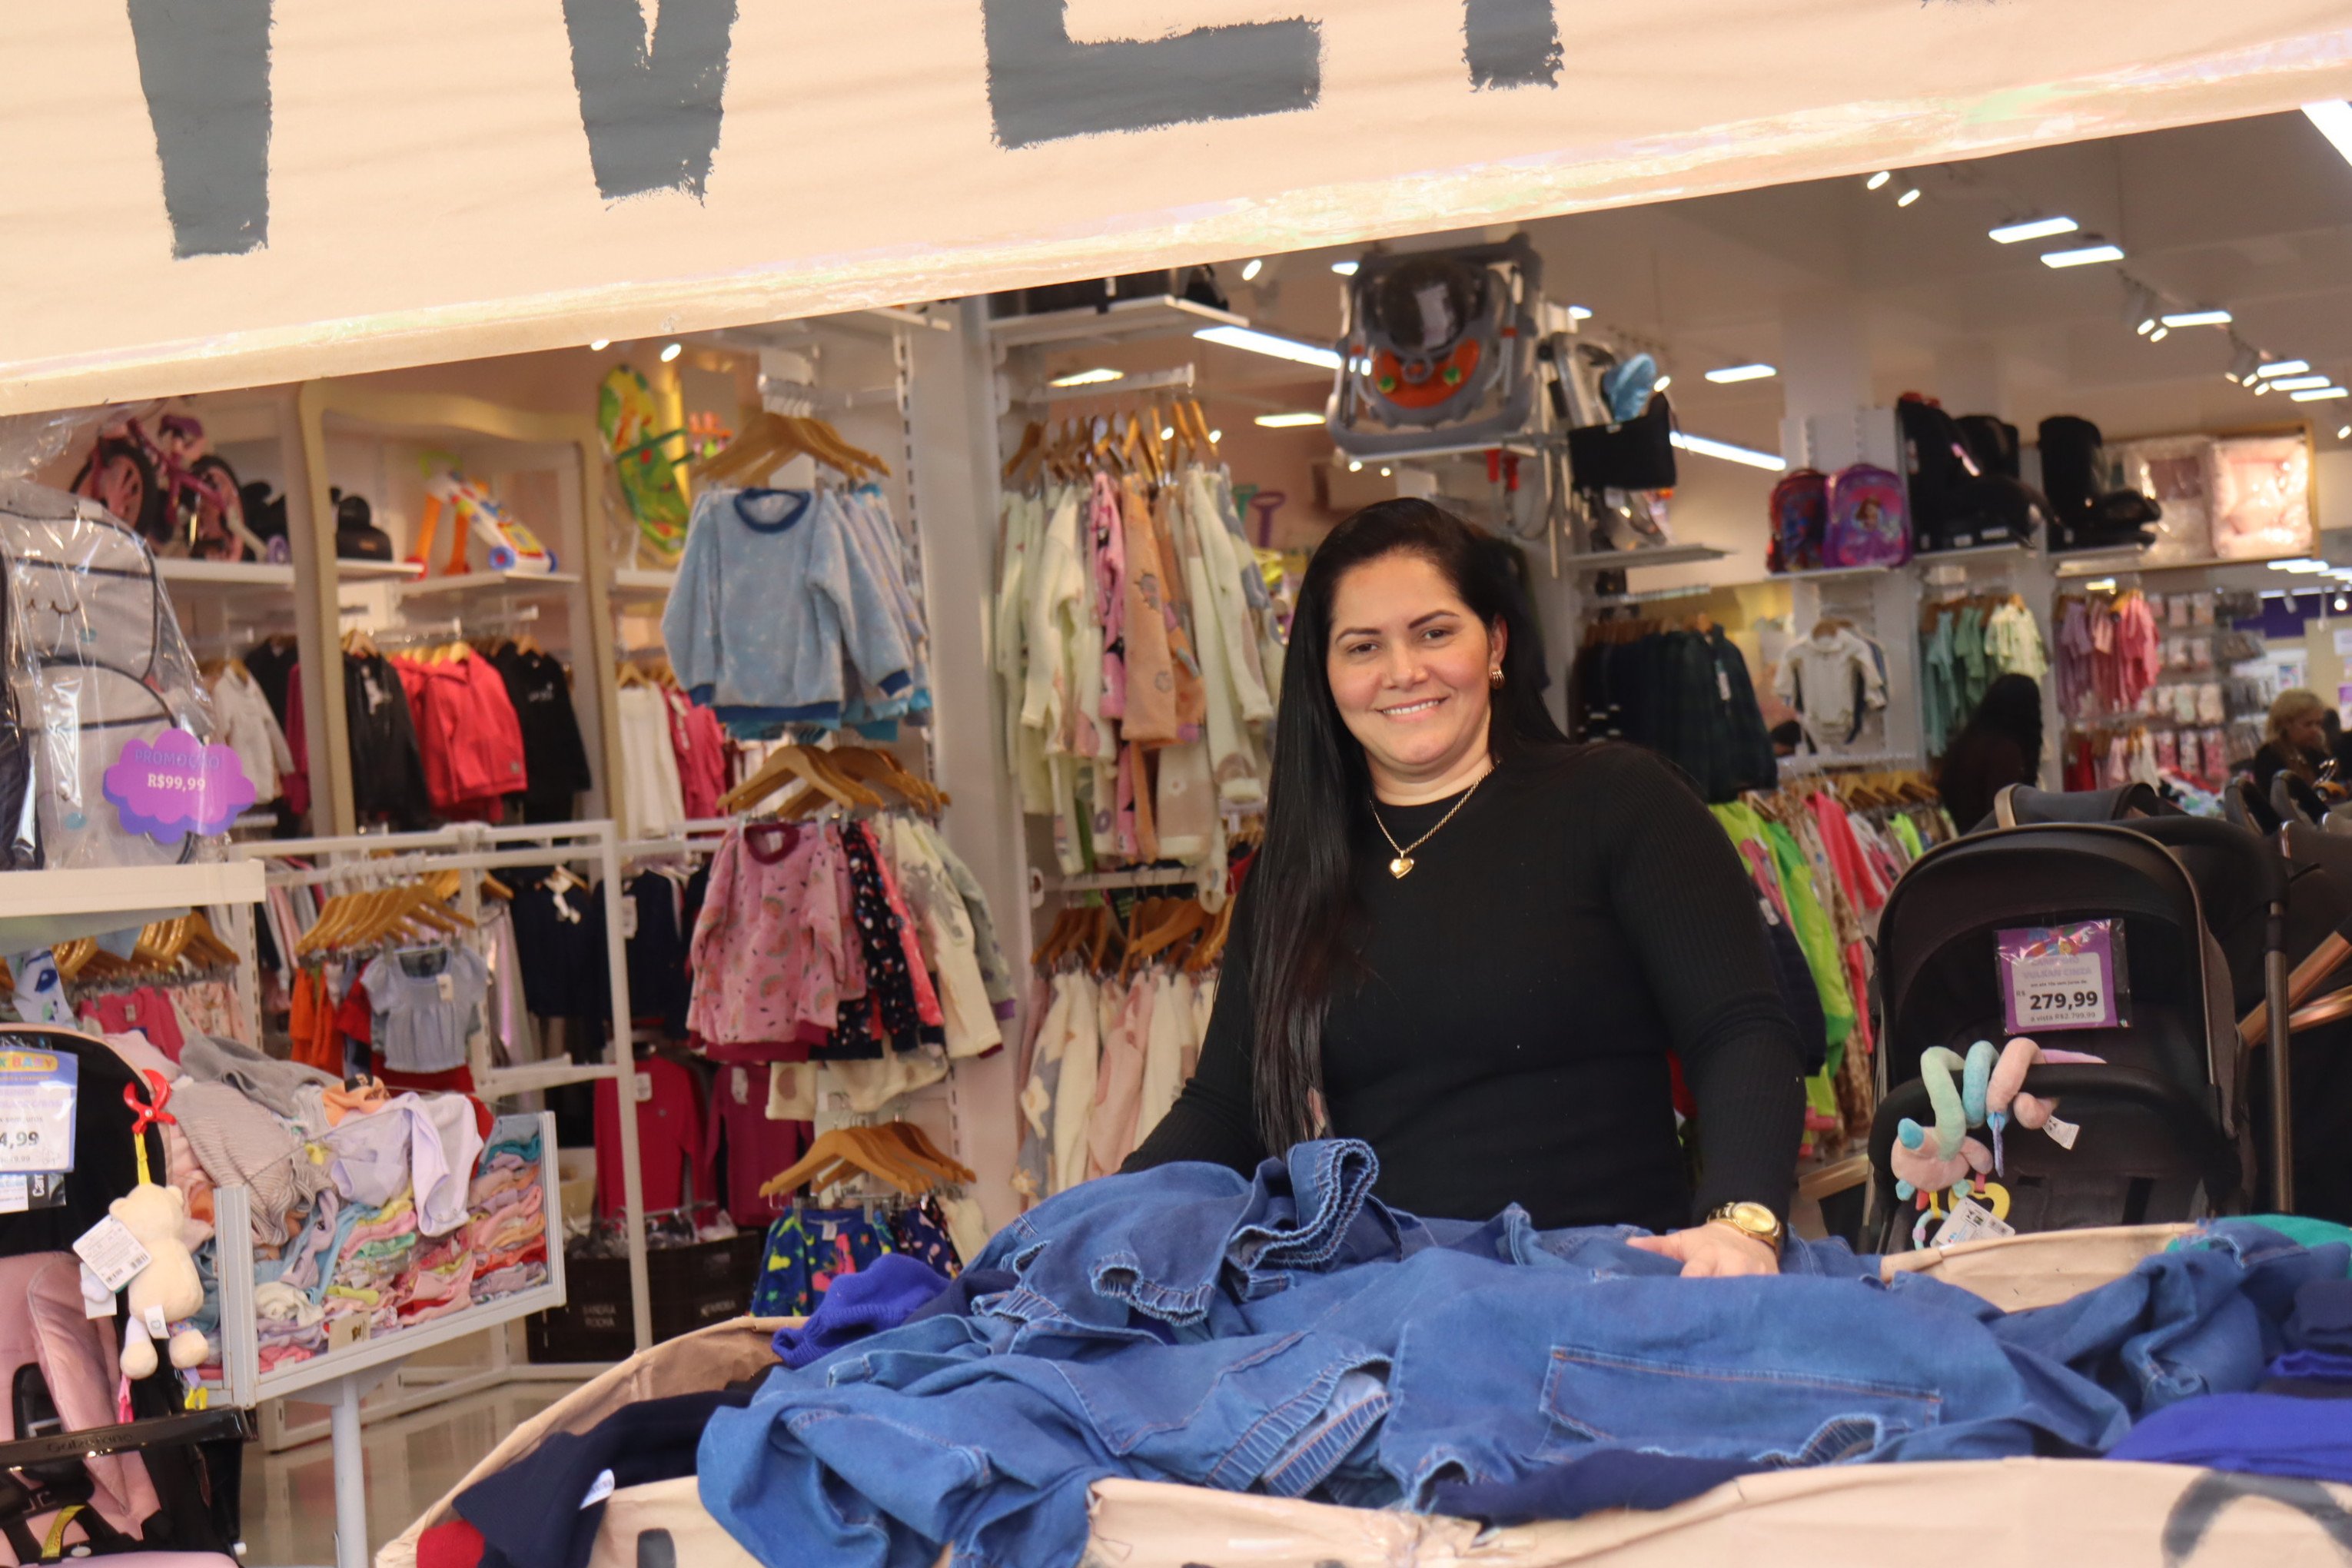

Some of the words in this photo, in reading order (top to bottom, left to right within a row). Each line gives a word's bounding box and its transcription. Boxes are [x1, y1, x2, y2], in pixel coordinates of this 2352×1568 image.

[147, 772, 206, 792] R$99,99
[2029, 990, 2098, 1011] 279,99
[12, 1055, 53, 1069] BABY
